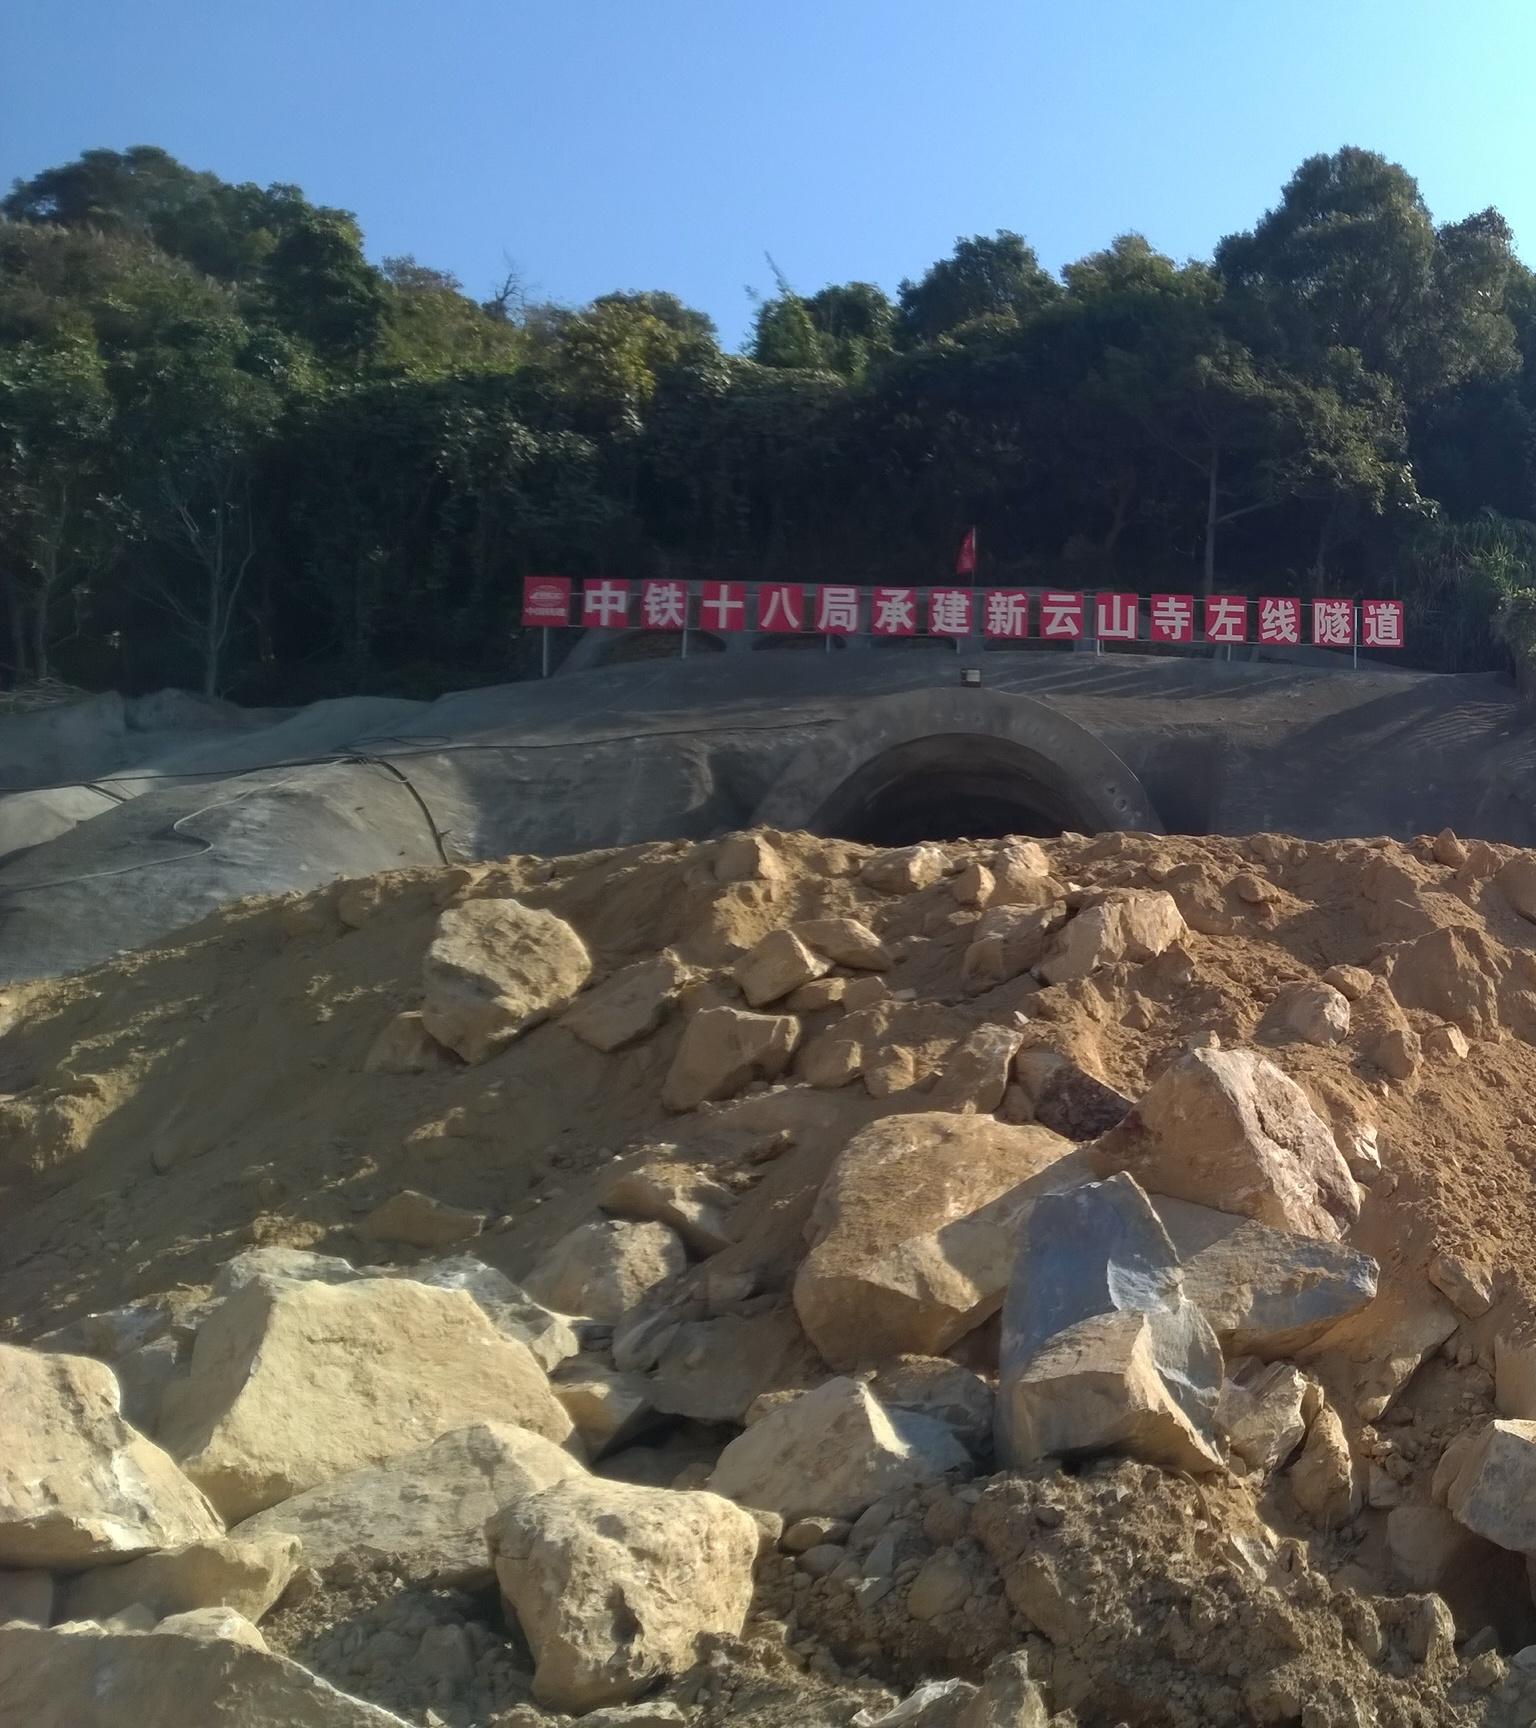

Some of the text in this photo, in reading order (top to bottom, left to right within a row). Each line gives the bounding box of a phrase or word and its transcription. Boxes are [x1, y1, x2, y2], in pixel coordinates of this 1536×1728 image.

[584, 581, 1401, 646] 中铁十八局承建新云山寺左线隧道
